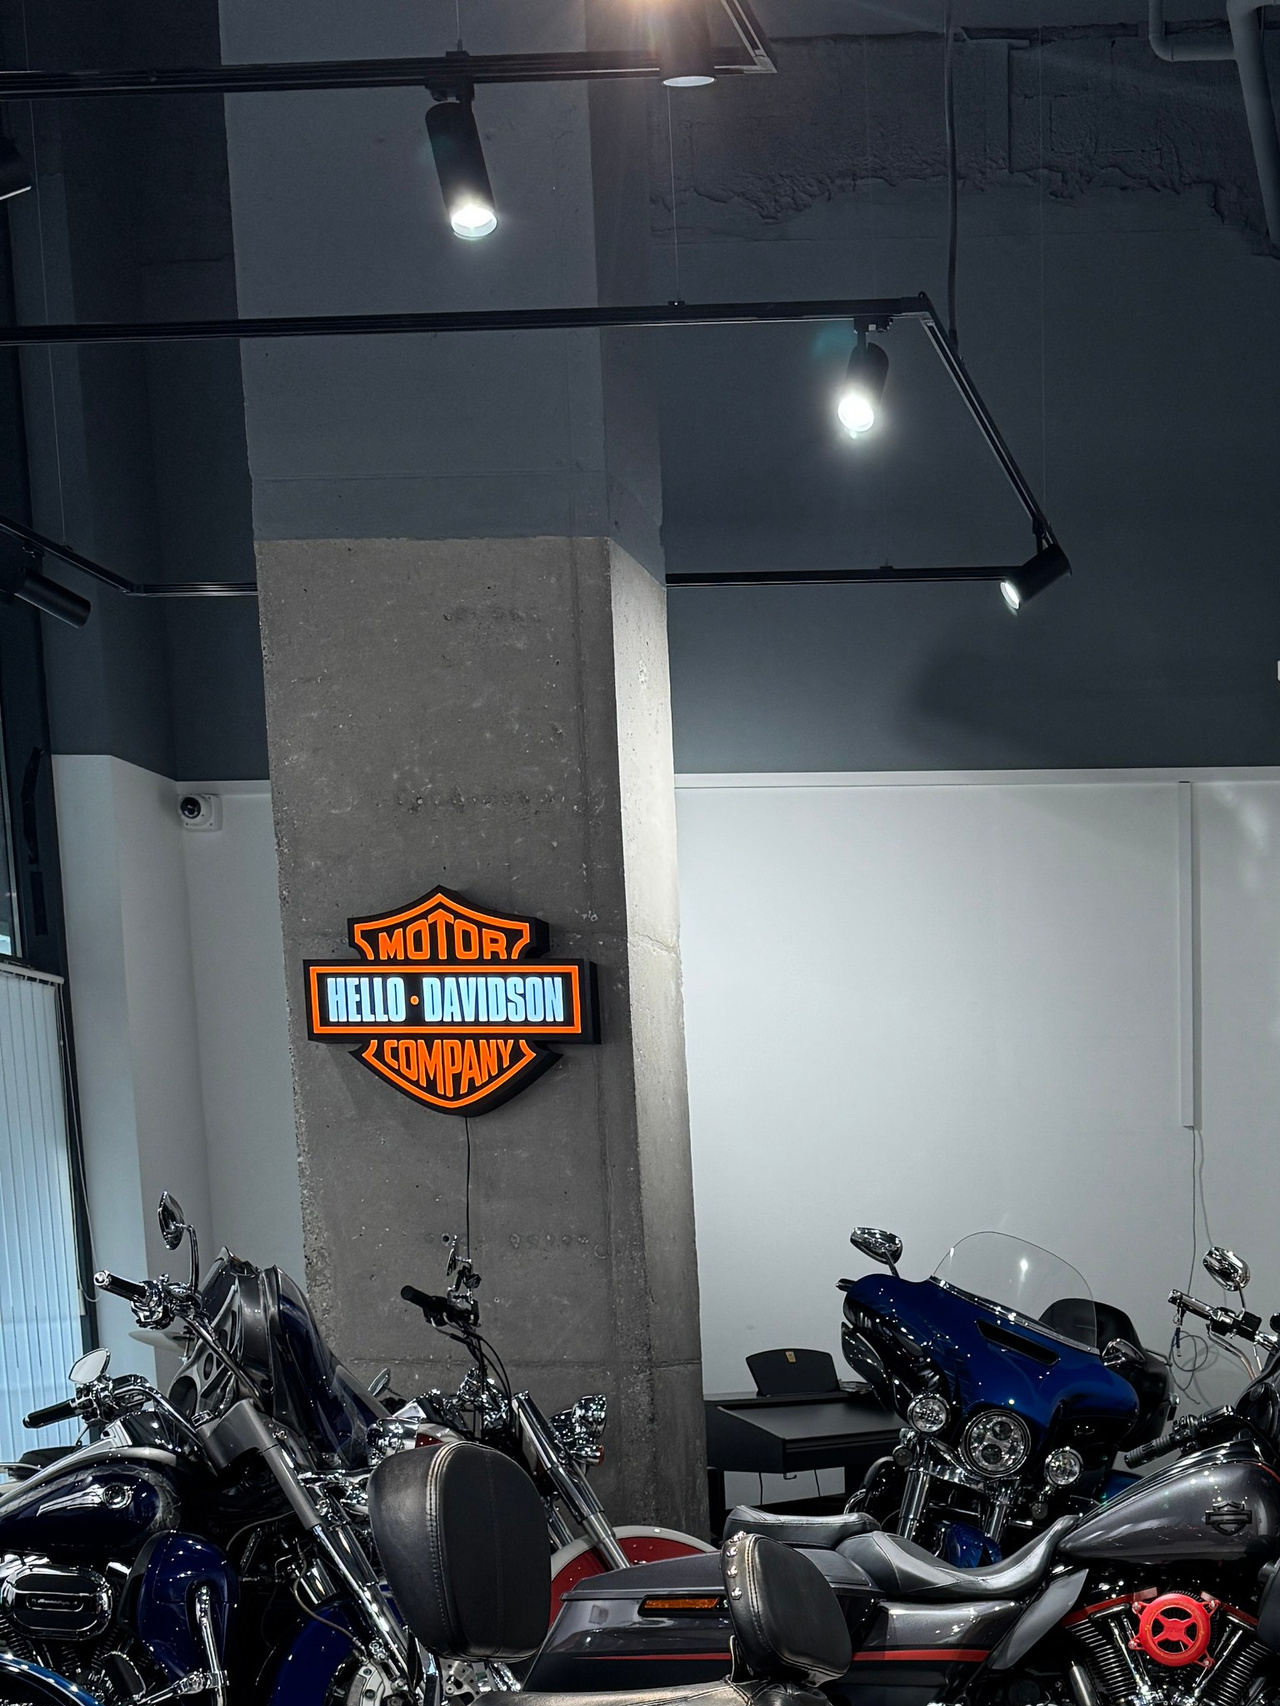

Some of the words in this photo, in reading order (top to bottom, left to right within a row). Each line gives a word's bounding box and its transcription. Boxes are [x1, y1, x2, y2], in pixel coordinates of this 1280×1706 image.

[378, 908, 508, 960] MOTOR
[326, 976, 406, 1022] HELLO
[422, 976, 564, 1022] DAVIDSON
[383, 1039, 514, 1097] COMPANY
